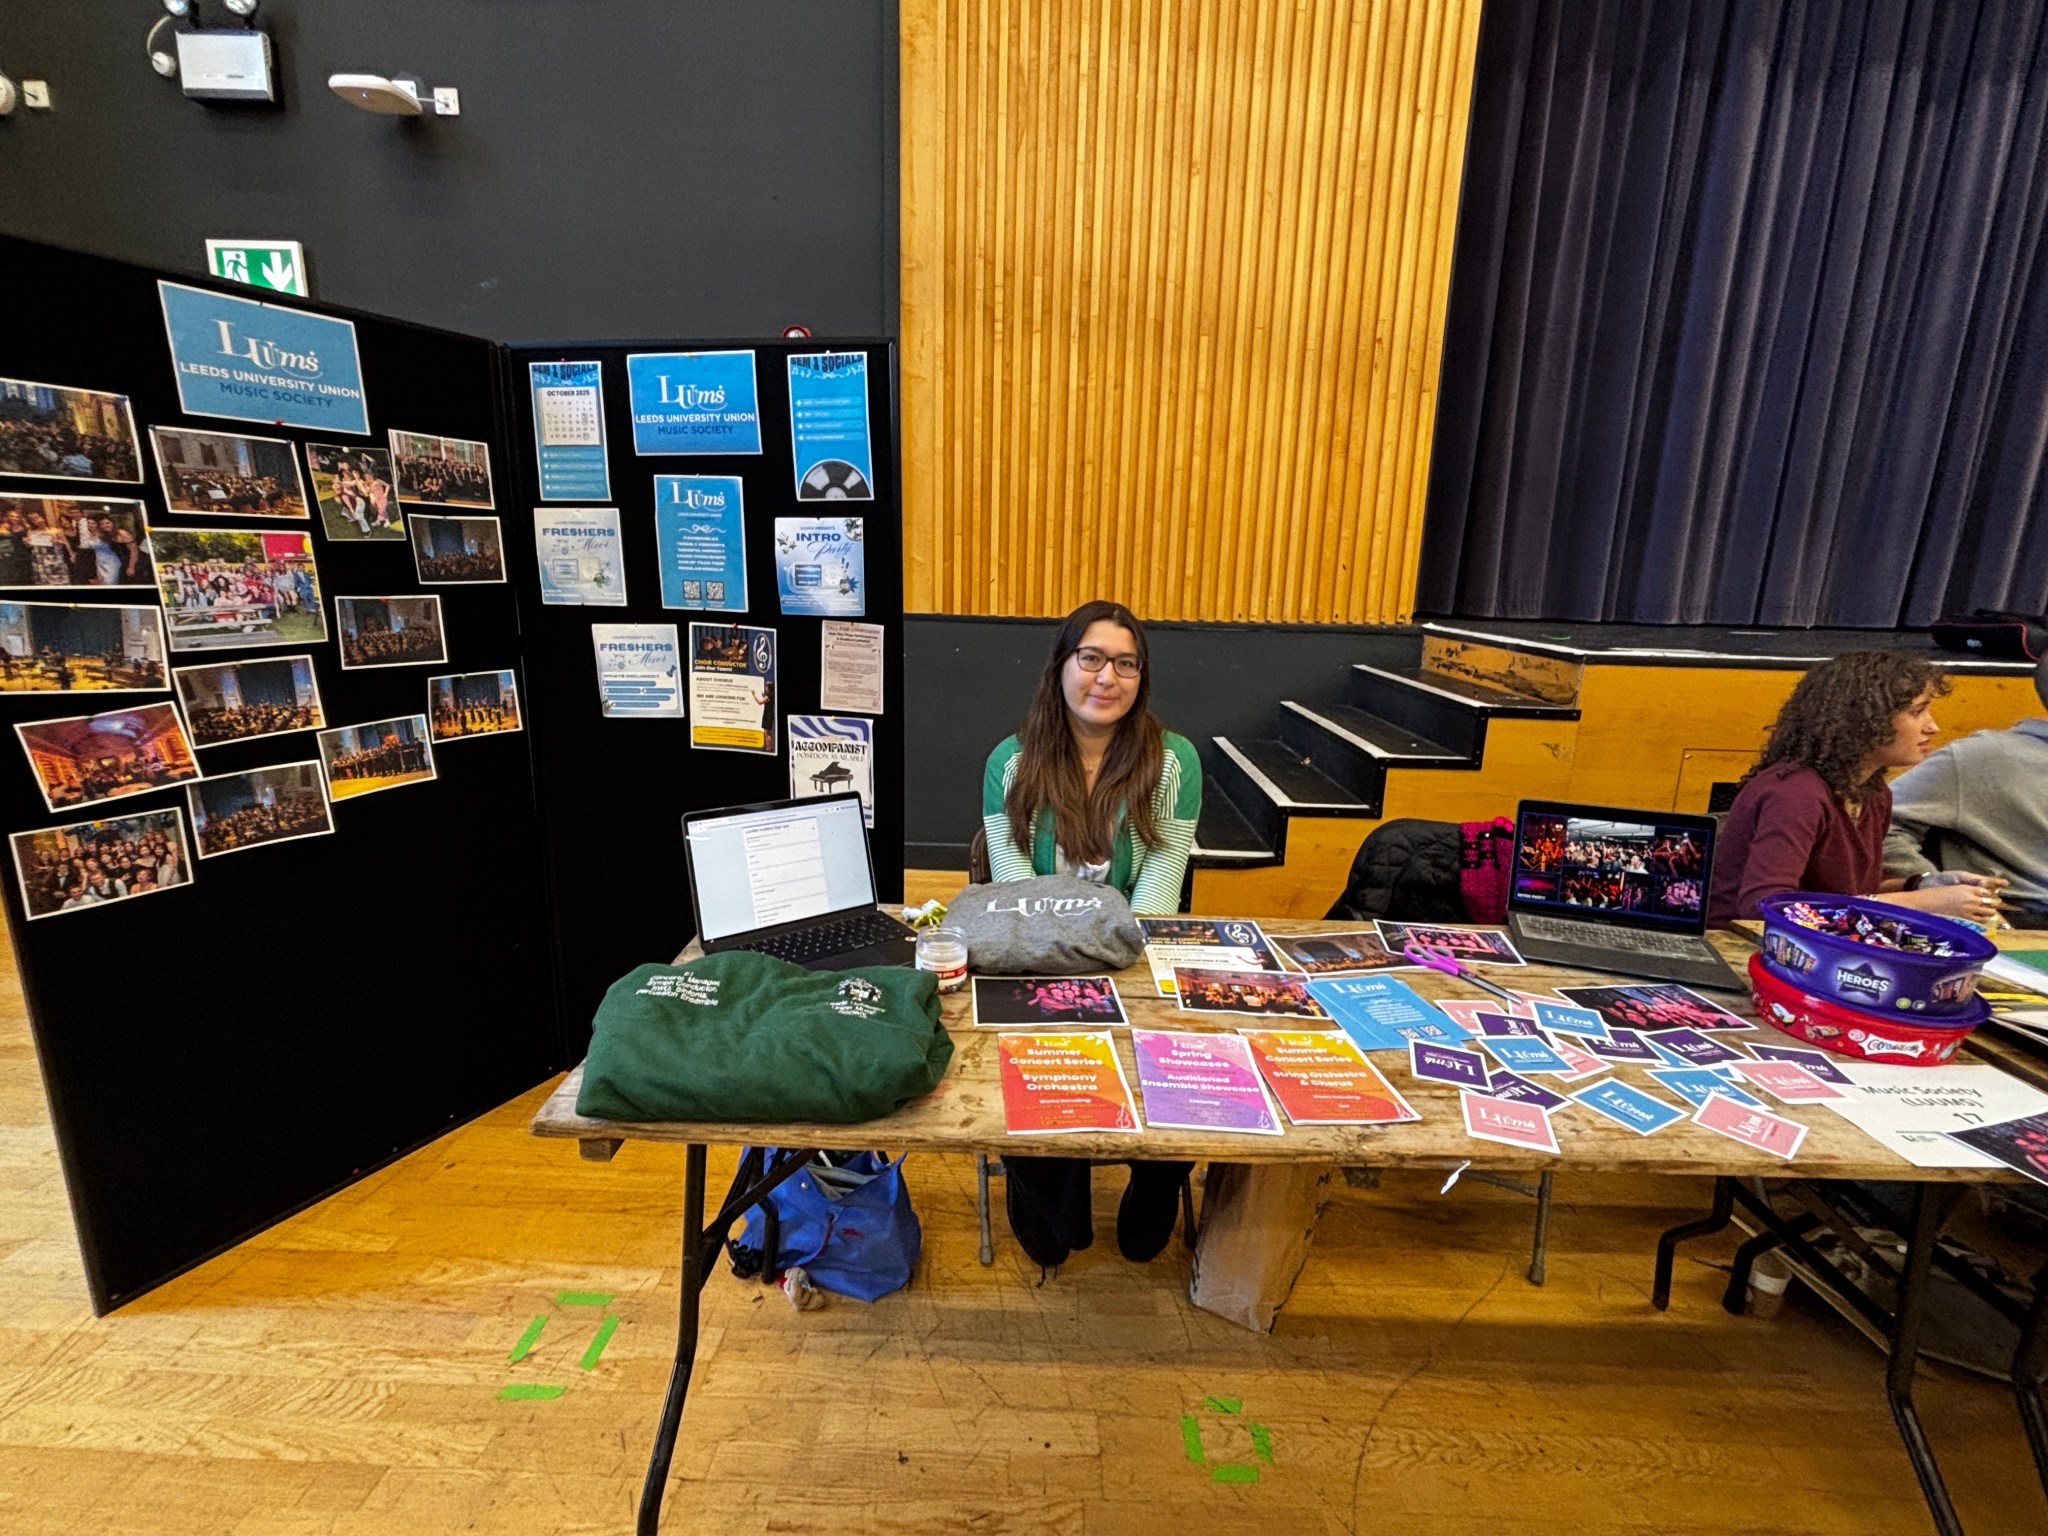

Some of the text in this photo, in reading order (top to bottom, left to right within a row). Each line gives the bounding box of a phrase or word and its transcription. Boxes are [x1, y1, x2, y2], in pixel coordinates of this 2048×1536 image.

[179, 361, 361, 399] LEEDS UNIVERSITY UNION
[219, 382, 334, 408] MUSIC SOCIETY
[635, 412, 755, 424] LEEDS UNIVERSITY UNION
[658, 425, 733, 435] MUSIC SOCIETY
[542, 528, 615, 536] FRESHERS
[796, 533, 841, 542] INTRO
[807, 541, 853, 561] Party
[600, 643, 673, 651] FRESHERS
[795, 741, 867, 755] ACCOMPANIST
[830, 754, 865, 762] AVAILABLE
[1837, 970, 1889, 991] HEROES
[1171, 1050, 1213, 1059] Spring
[1265, 1055, 1353, 1063] Concert Series
[1158, 1057, 1231, 1068] Showcases
[1022, 1074, 1097, 1082] Symphony
[1167, 1074, 1230, 1083] Auditioned
[1272, 1071, 1309, 1079] String
[1026, 1083, 1098, 1091] Orchestra
[1142, 1080, 1260, 1093] Ensemble Showcase
[1858, 1086, 1982, 1097] Music Society
[1900, 1098, 1984, 1109] (LUUMS)
[1952, 1112, 1984, 1125] 17
